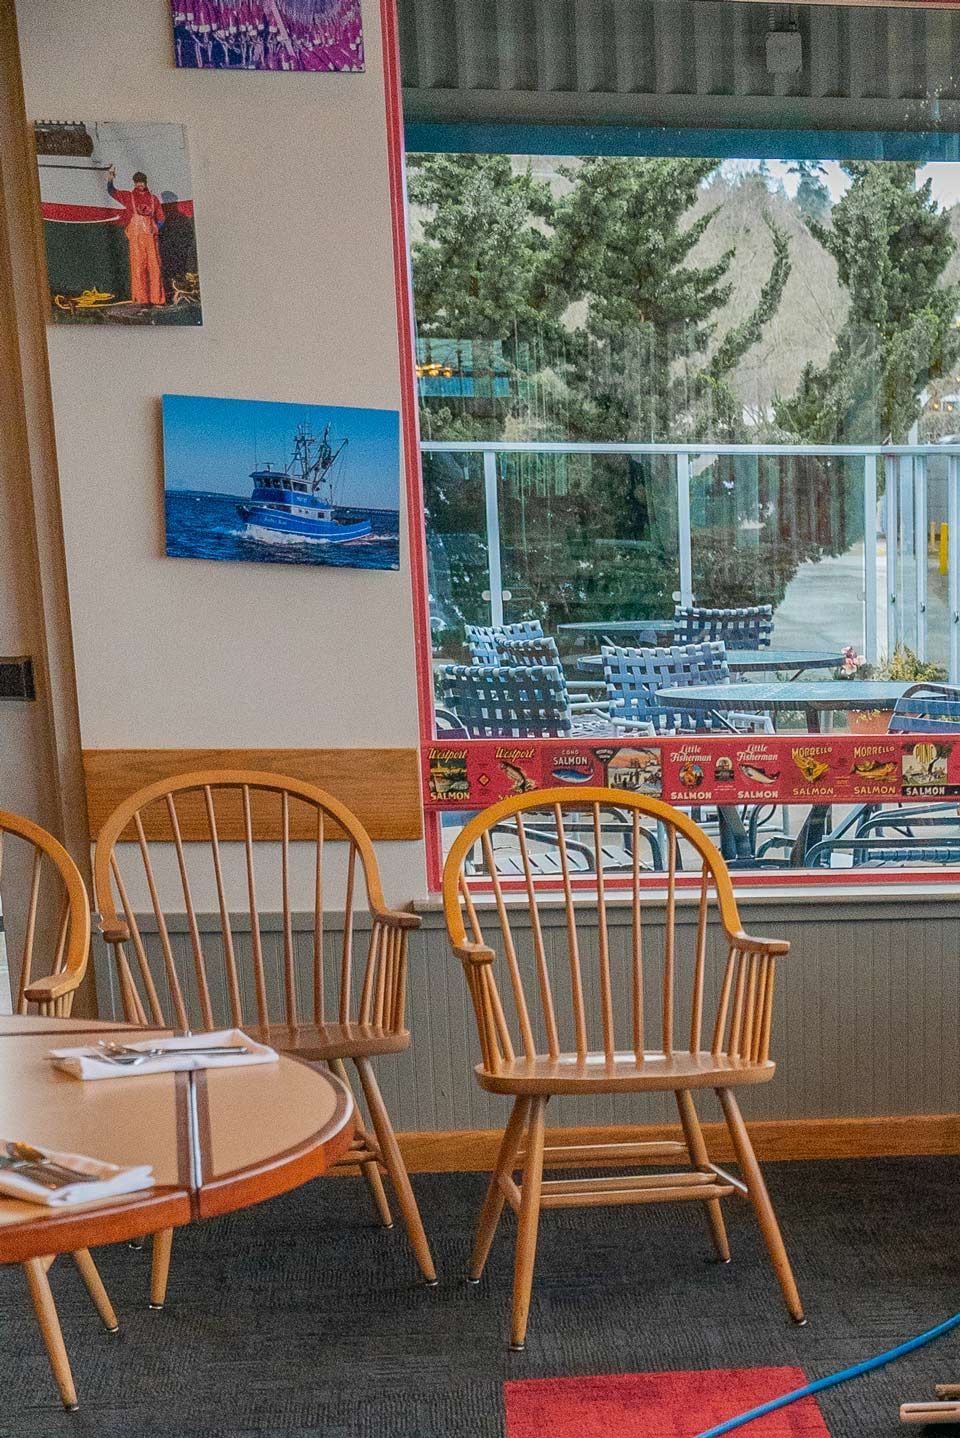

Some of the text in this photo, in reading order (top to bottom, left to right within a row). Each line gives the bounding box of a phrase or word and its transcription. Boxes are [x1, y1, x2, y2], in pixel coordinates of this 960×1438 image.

[679, 745, 702, 754] Little
[745, 744, 768, 753] Little
[791, 747, 832, 759] MORRELLO
[853, 746, 894, 758] MORRELLO
[428, 747, 468, 764] Westport
[495, 746, 535, 763] Westport
[670, 752, 712, 762] Fisherman
[736, 751, 778, 761] Fisherman
[553, 756, 588, 766] SALMON
[737, 790, 779, 799] SALMON
[792, 787, 834, 795] SALMON
[853, 786, 896, 795] SALMON
[906, 786, 945, 795] SALMON
[430, 791, 471, 800] SALMON
[670, 791, 712, 800] SALMON
